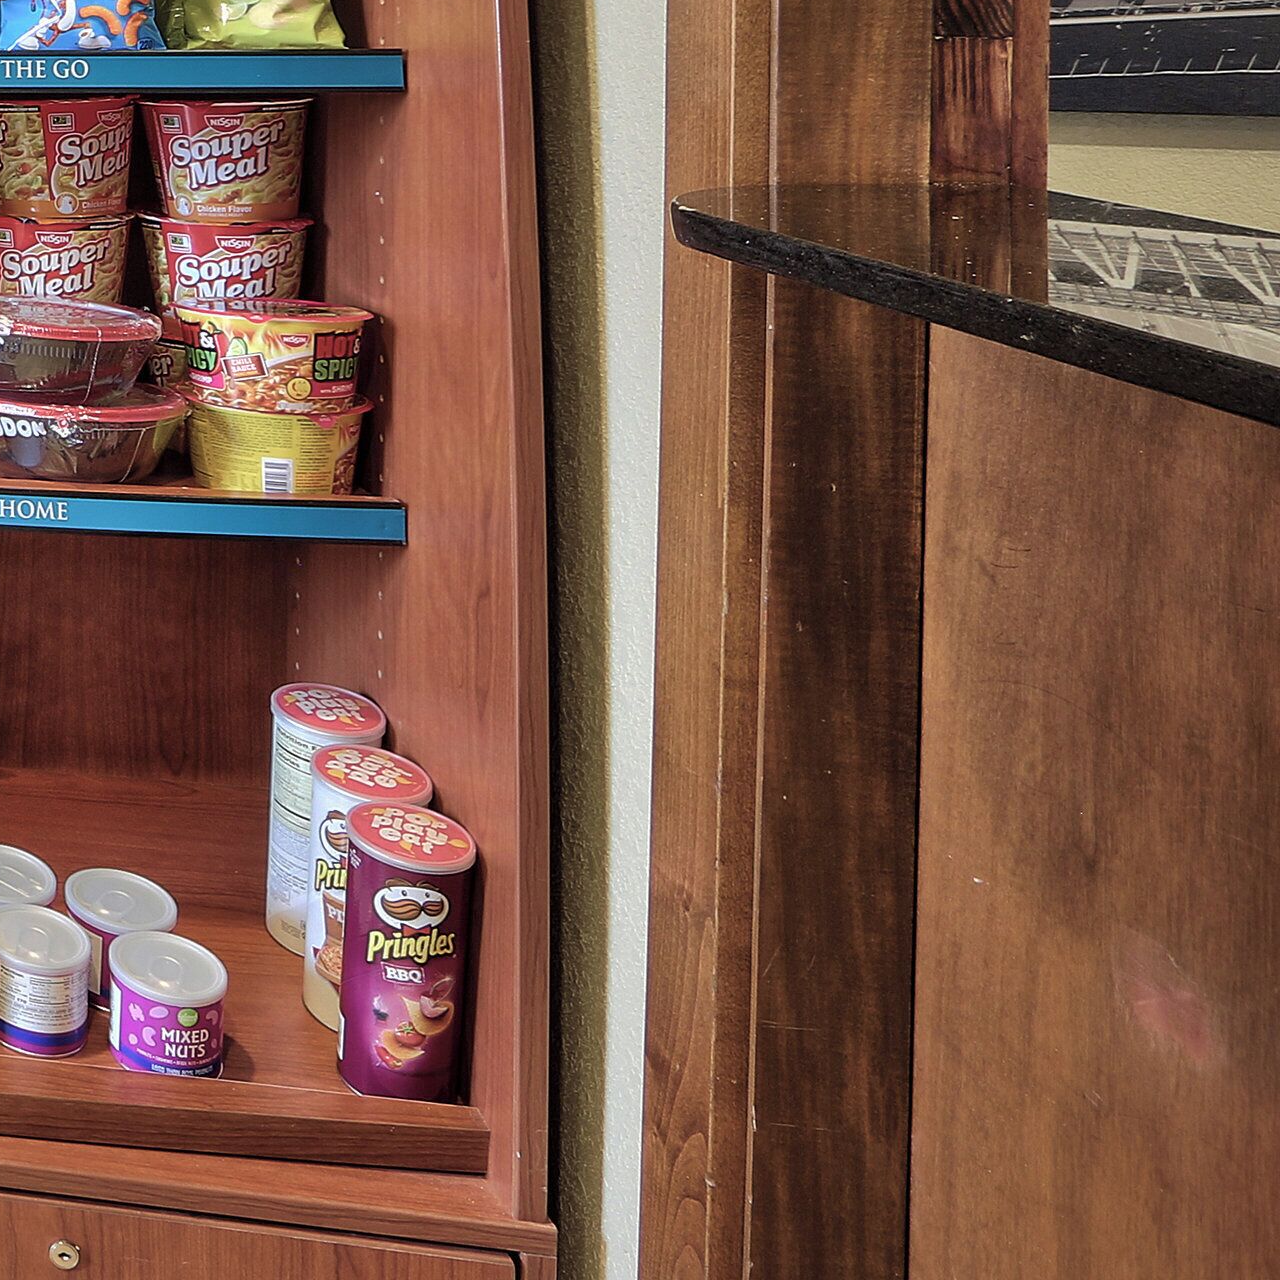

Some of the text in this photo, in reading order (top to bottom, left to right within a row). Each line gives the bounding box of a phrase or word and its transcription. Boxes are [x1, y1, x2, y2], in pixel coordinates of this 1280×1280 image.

[0, 59, 46, 79] THE
[53, 59, 89, 79] GO
[208, 116, 241, 127] NISSIN
[171, 121, 285, 166] Souper
[190, 150, 268, 188] Meal
[197, 205, 252, 214] Chicken Flavor
[39, 234, 69, 244] NISSIN
[220, 239, 252, 248] NISSIN
[3, 238, 108, 280] Souper
[178, 241, 291, 287] Souper
[0, 499, 69, 521] HOME
[383, 806, 447, 831] pop
[371, 815, 448, 846] play
[379, 827, 435, 855] eat
[367, 931, 456, 965] Pringles
[385, 965, 425, 983] BBQ
[161, 1027, 209, 1044] MIXED
[165, 1043, 206, 1058] NUTS
